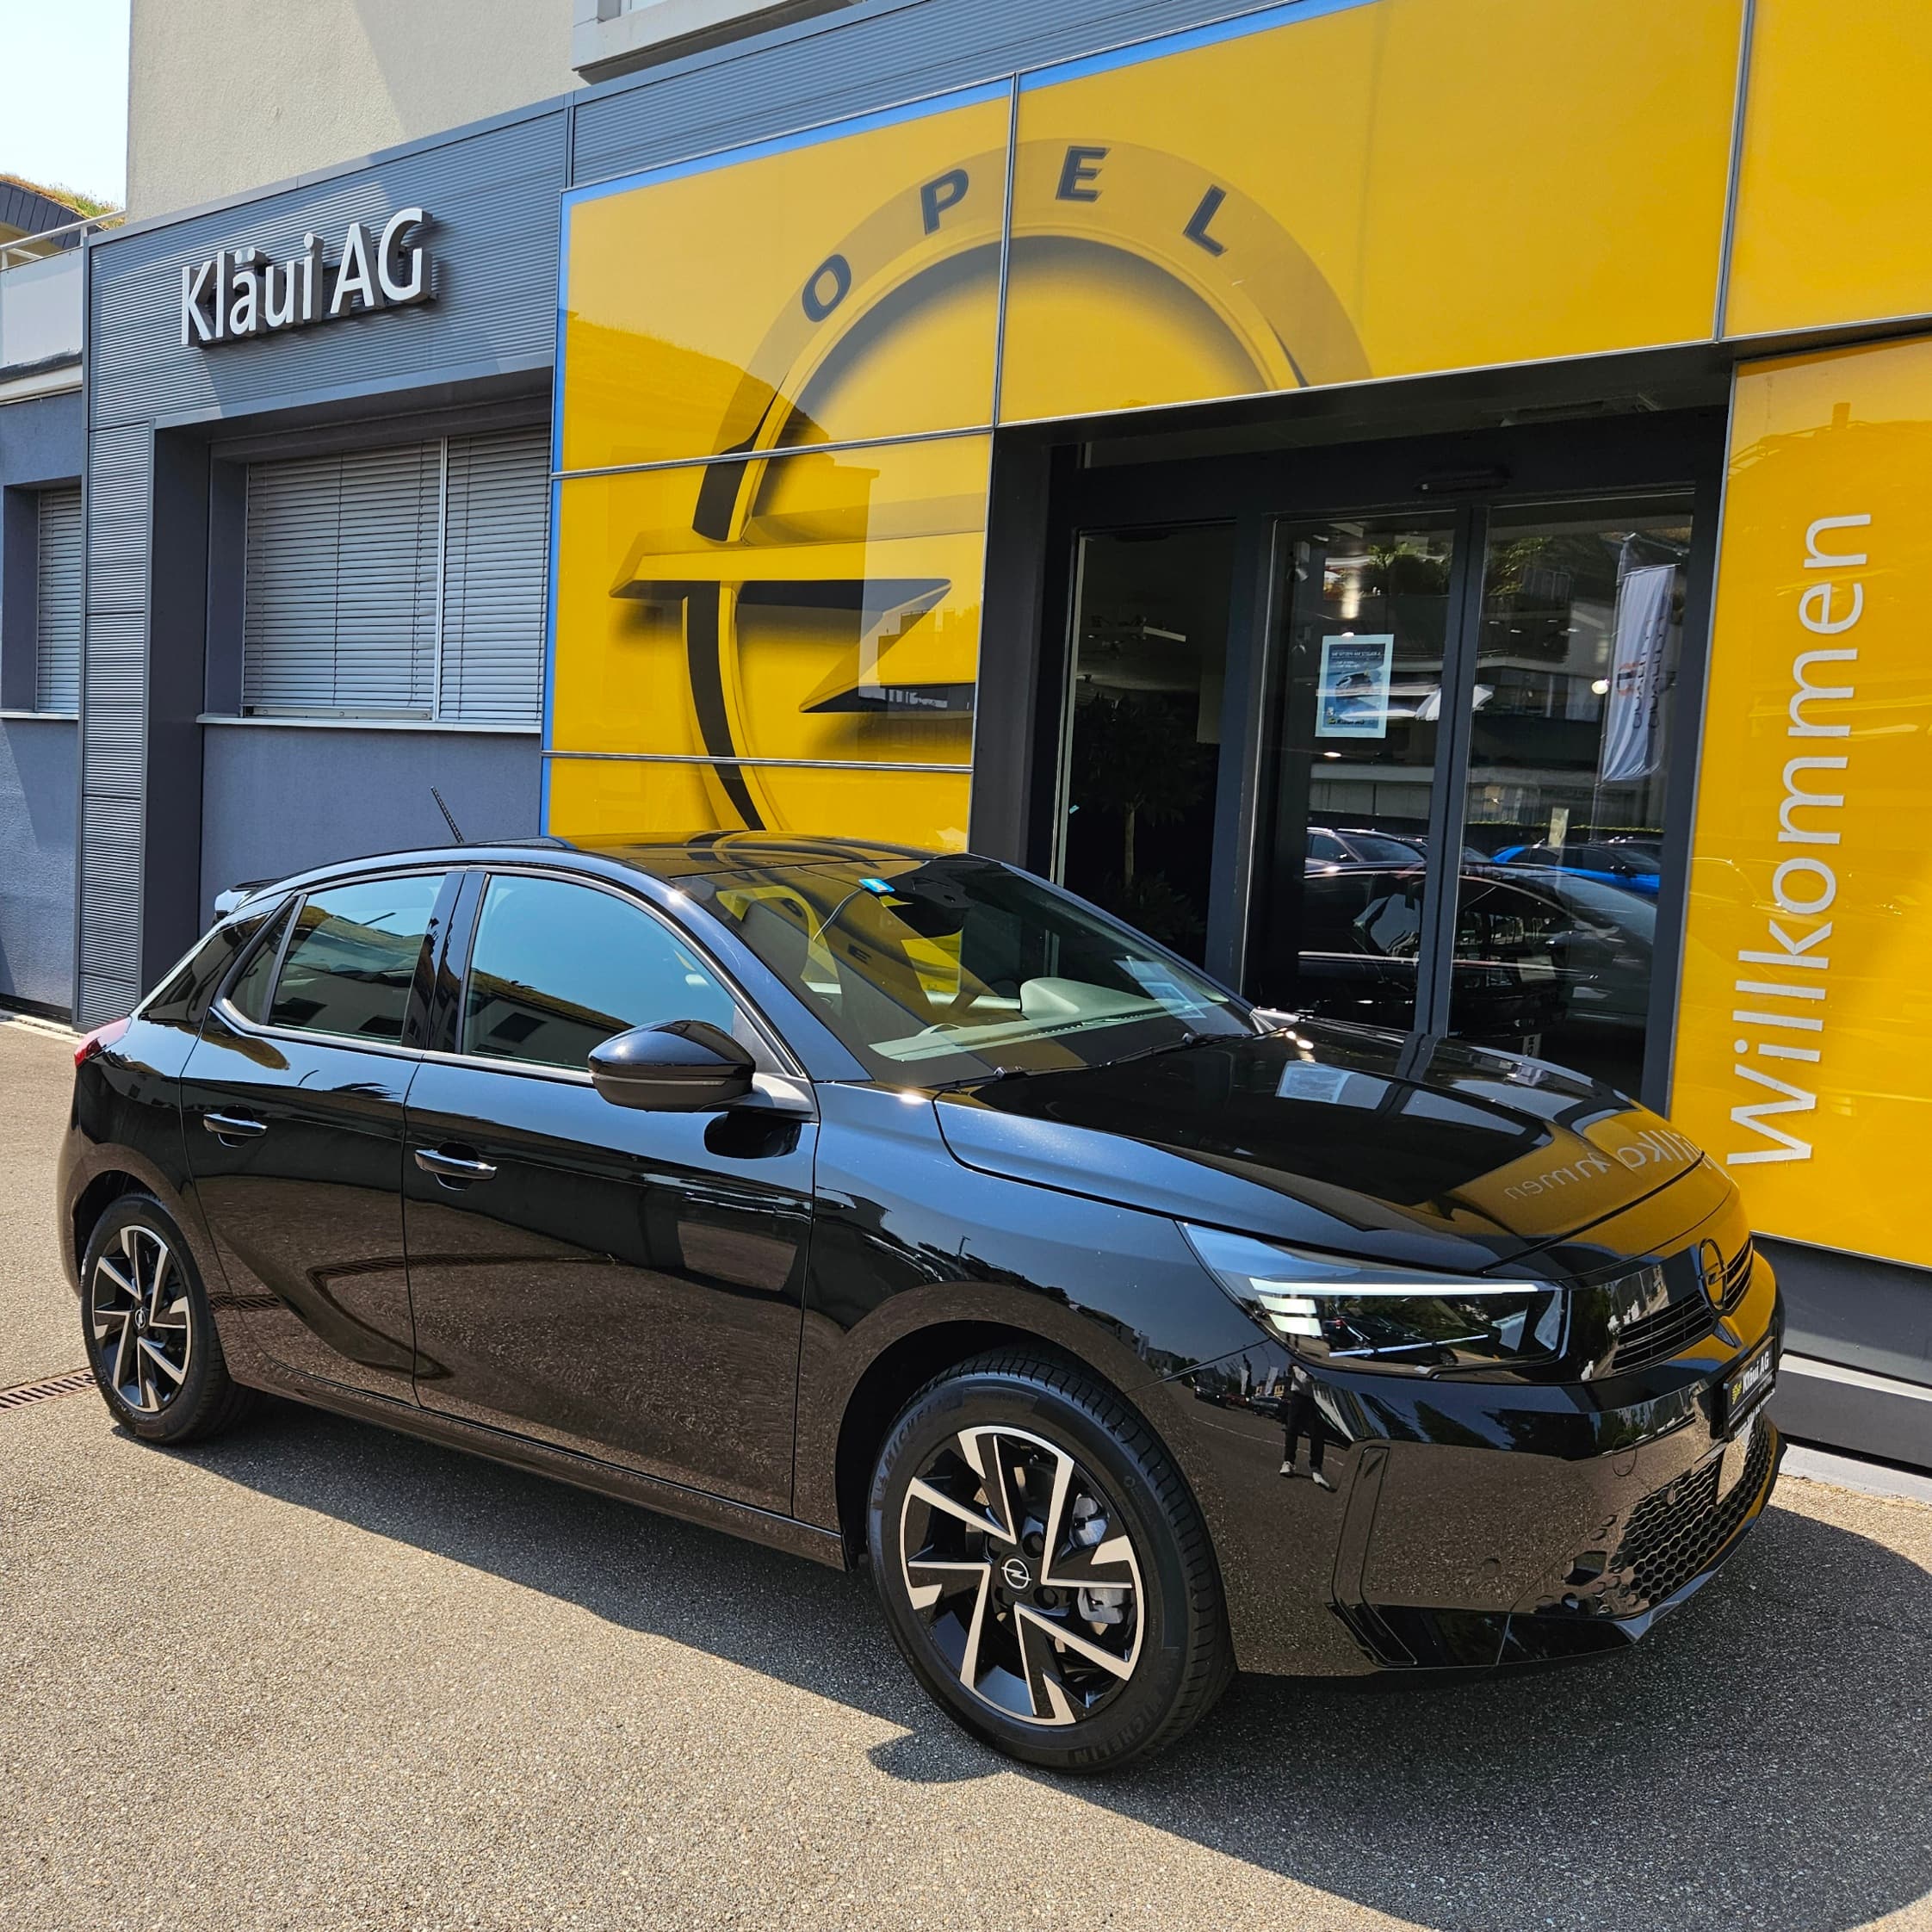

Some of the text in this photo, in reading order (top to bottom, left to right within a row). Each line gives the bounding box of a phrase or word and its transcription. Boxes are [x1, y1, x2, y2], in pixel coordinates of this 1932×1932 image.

[181, 207, 424, 345] Kläui AG
[802, 146, 1227, 322] OPEL
[1726, 513, 1872, 1166] Willkommen
[1760, 1351, 1769, 1376] AG
